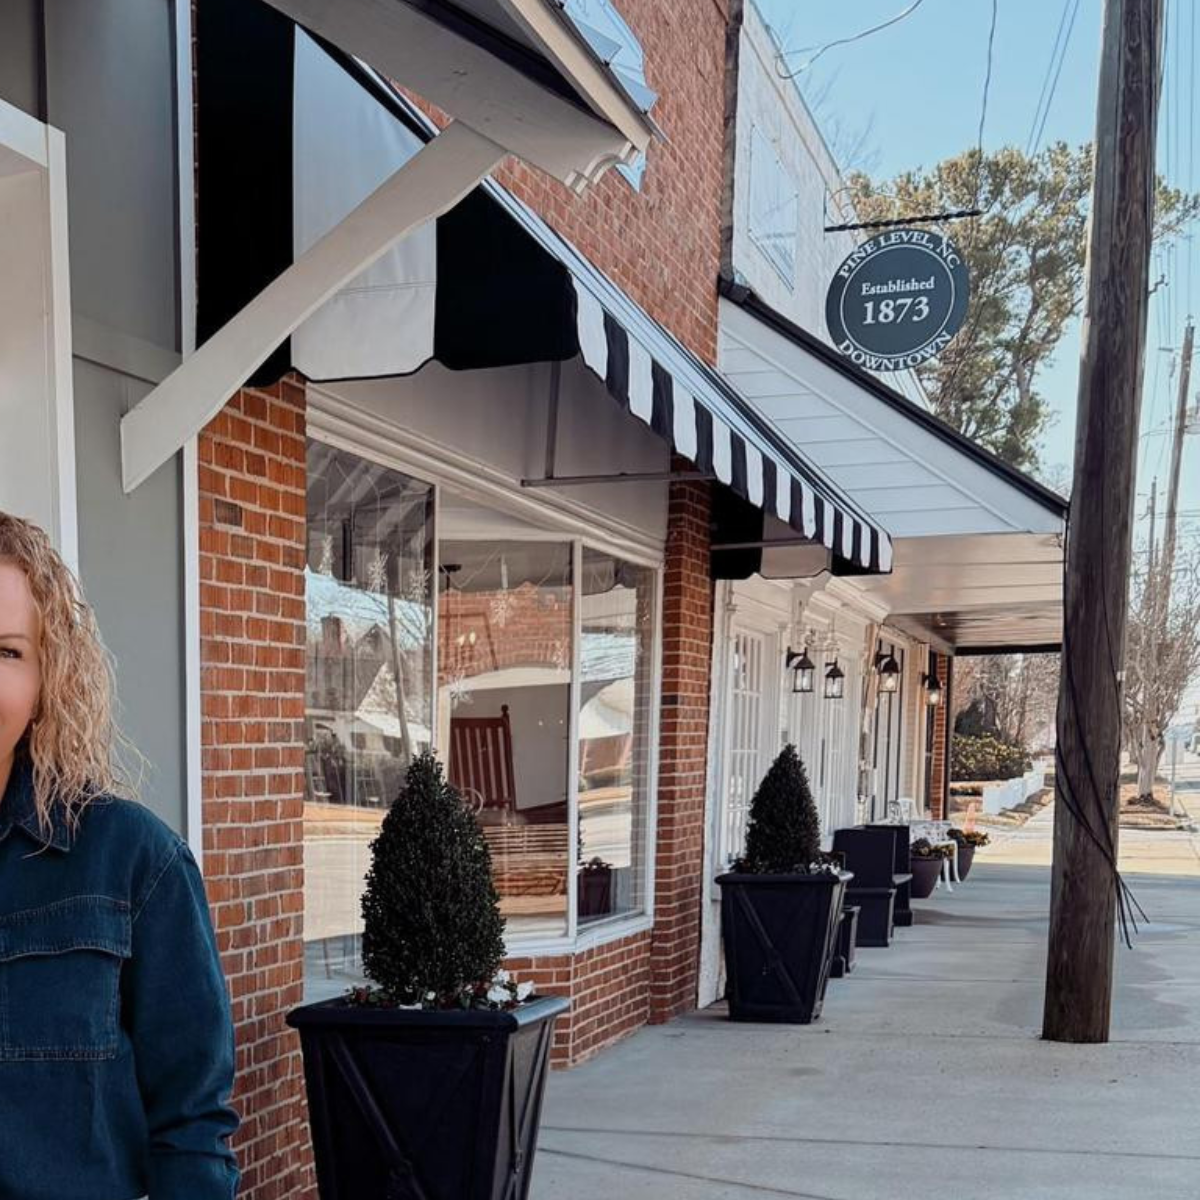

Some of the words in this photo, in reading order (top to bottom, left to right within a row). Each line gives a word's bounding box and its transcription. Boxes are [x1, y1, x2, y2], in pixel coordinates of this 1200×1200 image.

[838, 243, 877, 279] PINE
[879, 231, 934, 248] LEVEL,
[936, 239, 961, 269] NC
[861, 276, 935, 295] Established
[862, 296, 930, 324] 1873
[838, 331, 952, 371] DOWNTOWN
